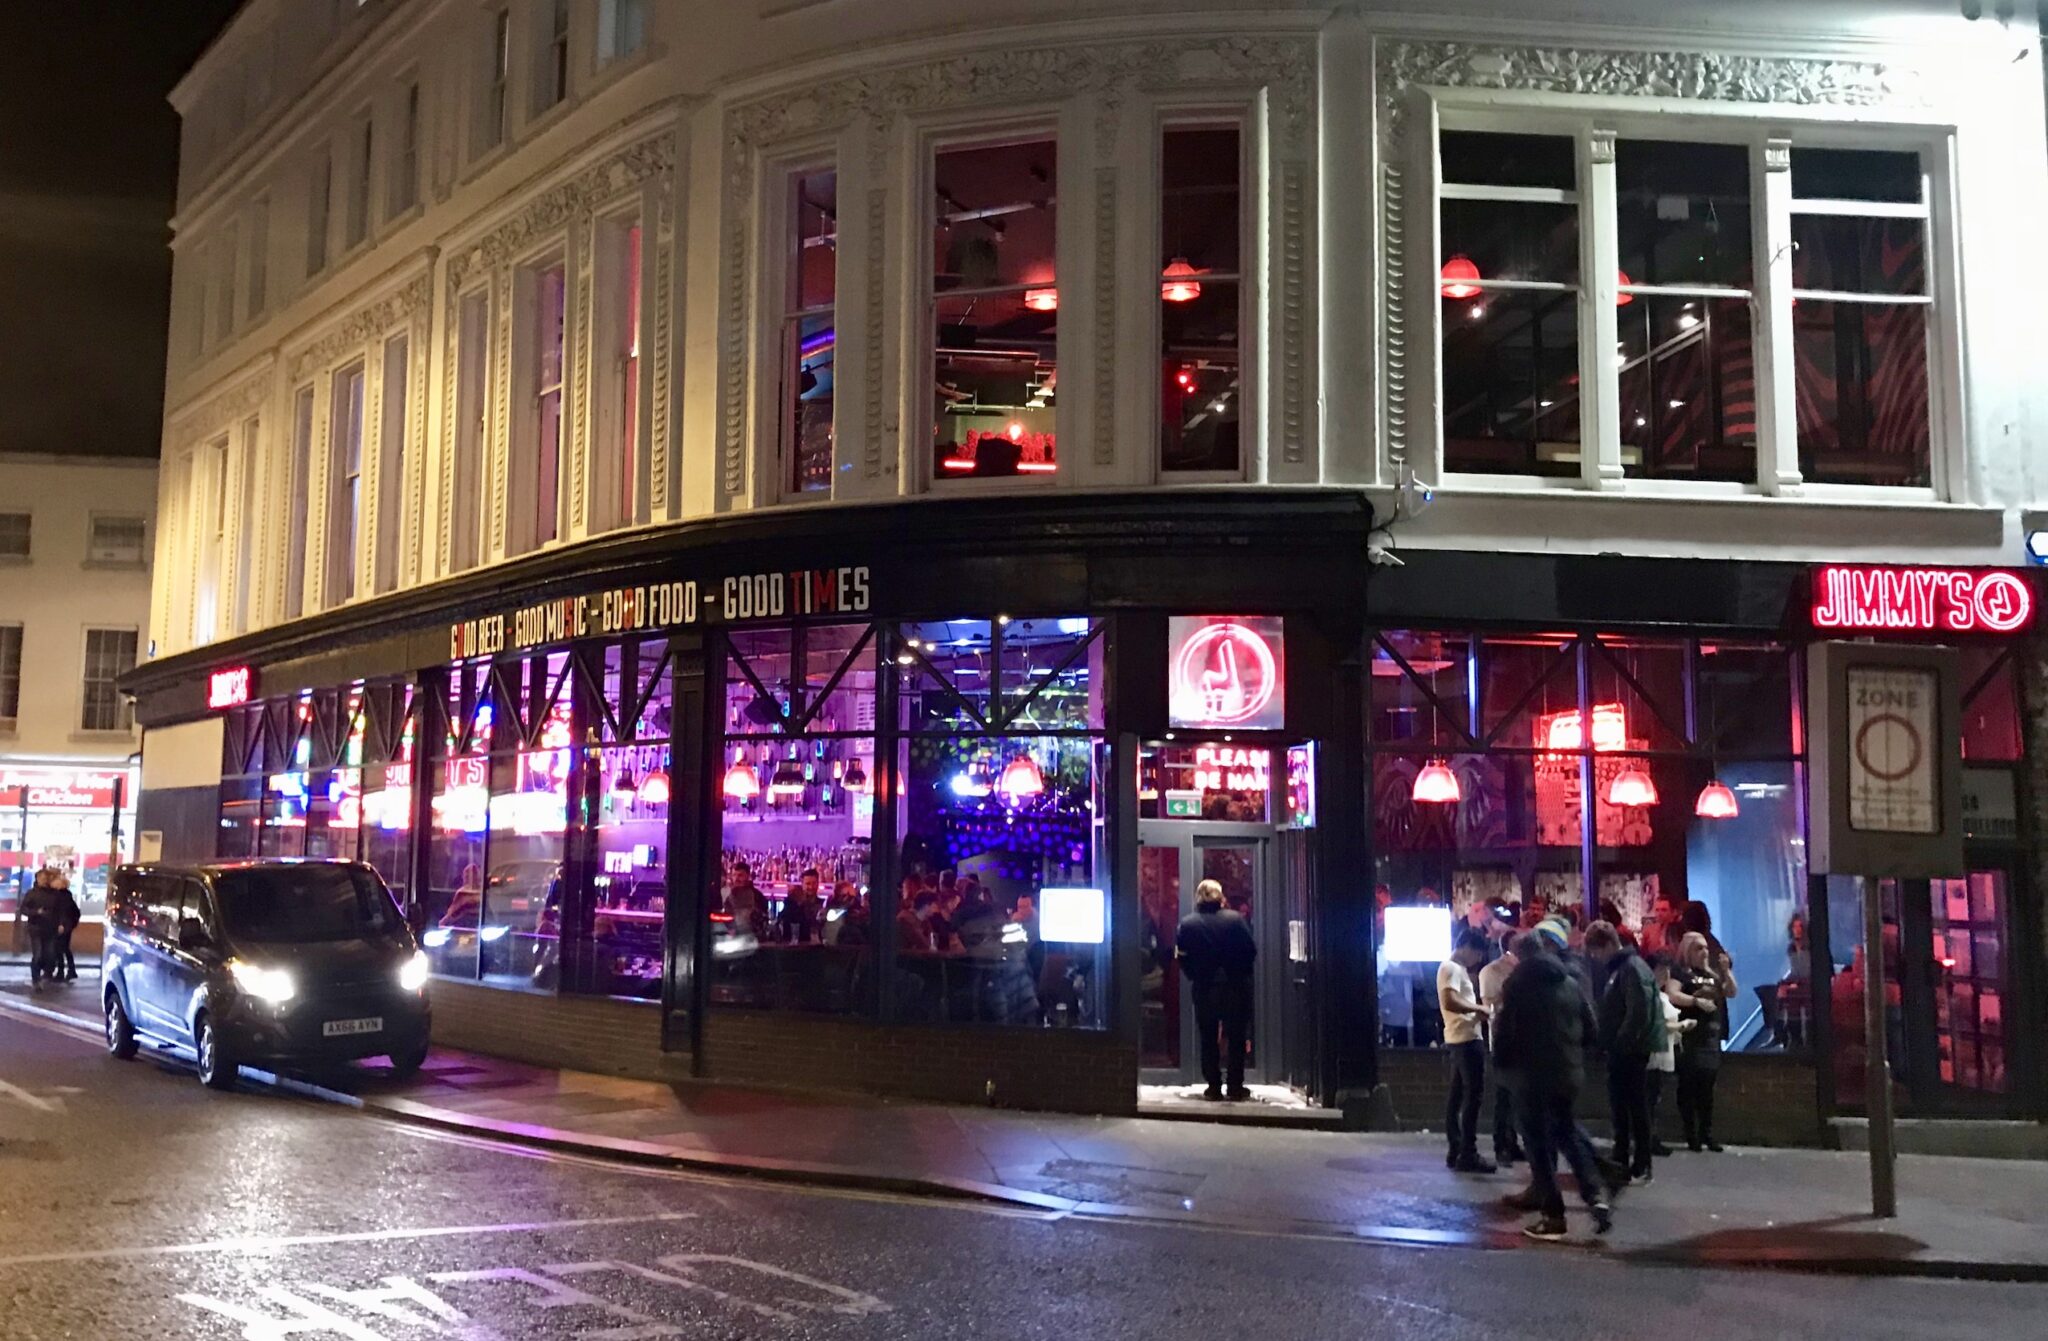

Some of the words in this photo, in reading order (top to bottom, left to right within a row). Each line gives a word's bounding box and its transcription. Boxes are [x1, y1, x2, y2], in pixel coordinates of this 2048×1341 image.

[450, 621, 477, 660] GOOD
[478, 614, 504, 655] BEER
[515, 605, 543, 648] GOOD
[545, 596, 587, 642] MUSIC
[602, 586, 645, 632] GOOD
[649, 581, 697, 627] FOOD
[723, 572, 784, 620] GOOD
[790, 566, 870, 615] TIMES
[1816, 568, 1974, 630] JIMMY'S
[1856, 688, 1918, 708] ZONE
[27, 788, 93, 806] Chicken
